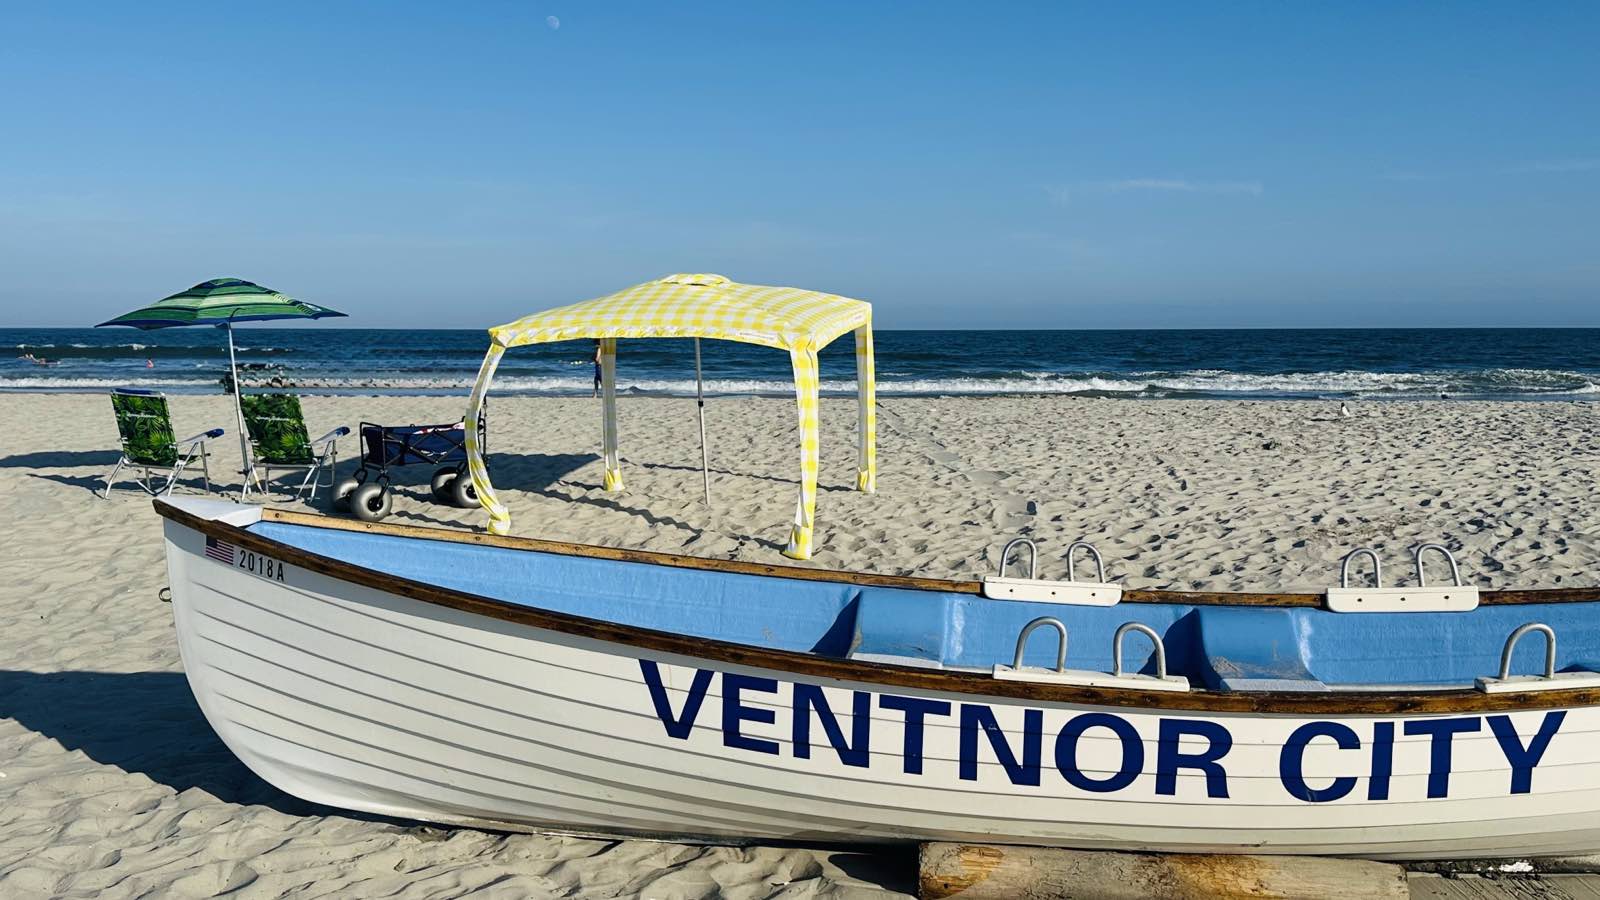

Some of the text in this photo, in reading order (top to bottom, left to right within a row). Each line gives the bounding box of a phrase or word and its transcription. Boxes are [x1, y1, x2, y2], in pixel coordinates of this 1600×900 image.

[239, 549, 285, 582] 2018A
[638, 659, 1567, 803] VENTNOR CITY
